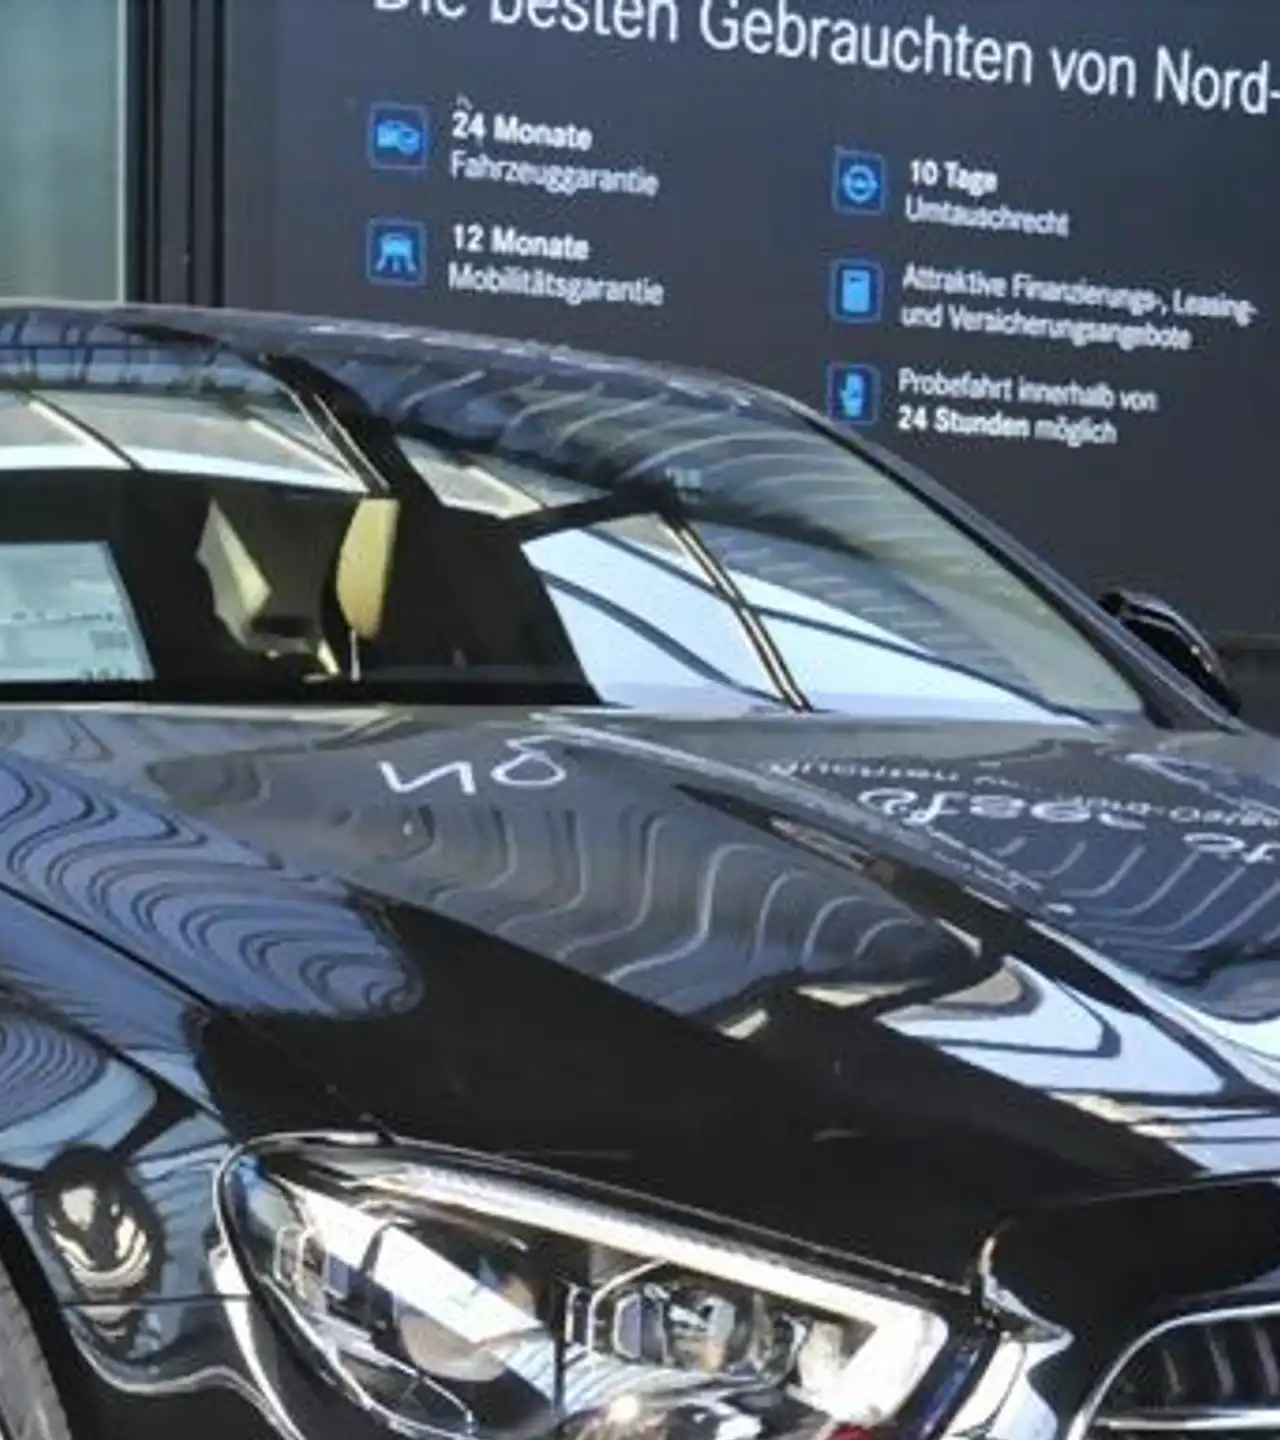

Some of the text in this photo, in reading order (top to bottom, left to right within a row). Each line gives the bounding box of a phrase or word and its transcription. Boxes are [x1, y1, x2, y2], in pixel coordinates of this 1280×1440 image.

[699, 0, 1034, 87] Gebrauchten
[1049, 46, 1137, 100] von
[451, 110, 593, 151] 24 Monate
[451, 150, 660, 197] Fahrzeuggarantie
[909, 159, 998, 197] 10 Tage
[905, 194, 1070, 238] Umtauschrecht
[453, 222, 590, 261] 12 Monate
[448, 261, 665, 306] Mobilitätsgarantie
[902, 260, 1008, 297] Attraktive
[900, 303, 943, 329] und
[898, 367, 1160, 413] Probefahrt innerhalb von
[897, 404, 1118, 449] 24 Stunden möglich
